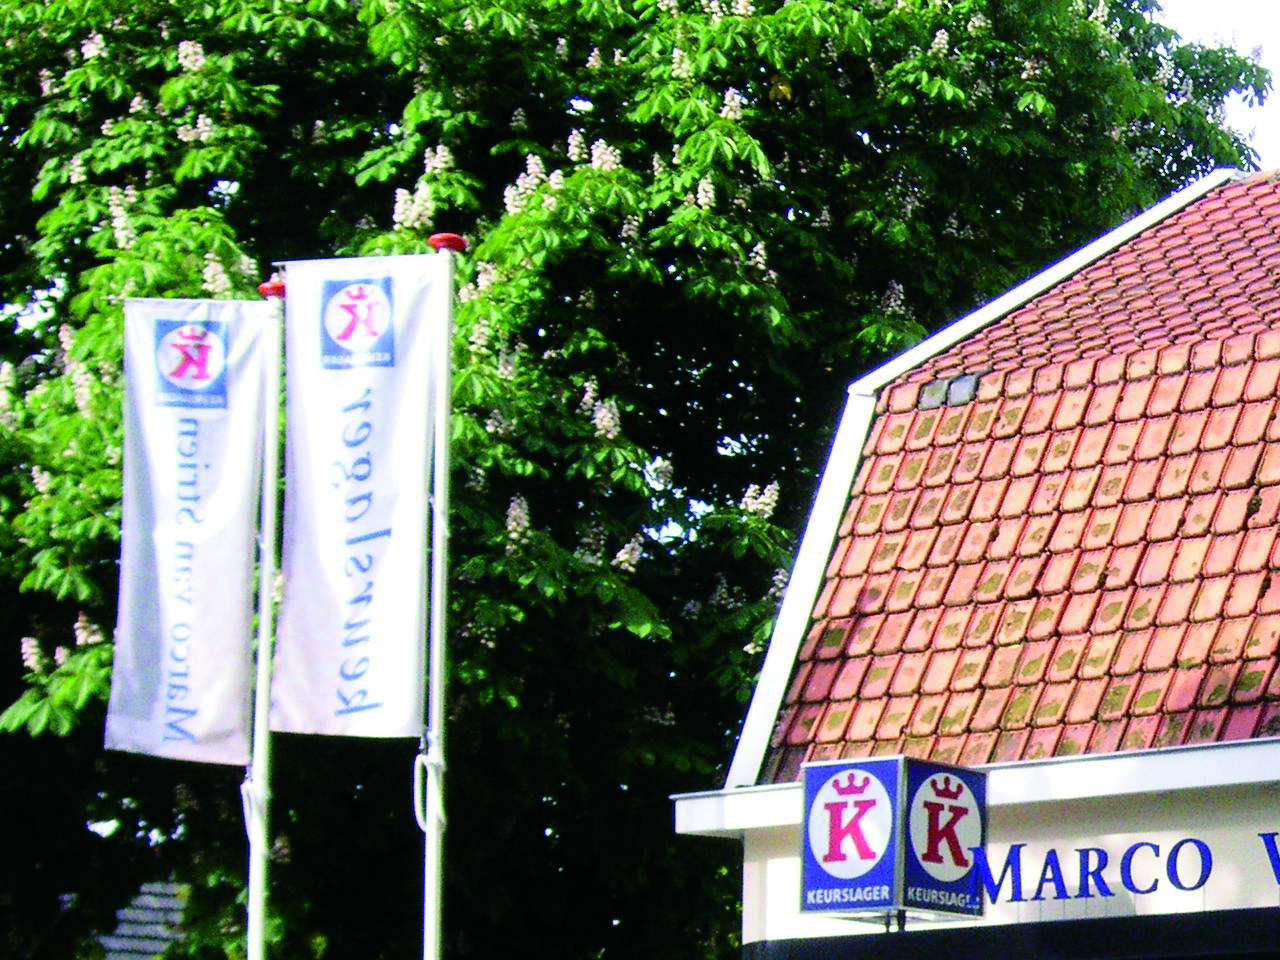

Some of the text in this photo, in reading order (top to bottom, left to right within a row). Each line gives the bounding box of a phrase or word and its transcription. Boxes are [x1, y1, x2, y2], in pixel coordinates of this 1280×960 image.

[822, 799, 876, 863] K
[921, 800, 969, 868] K
[807, 885, 890, 905] KEURSLAGER
[968, 838, 1213, 905] MARCO
